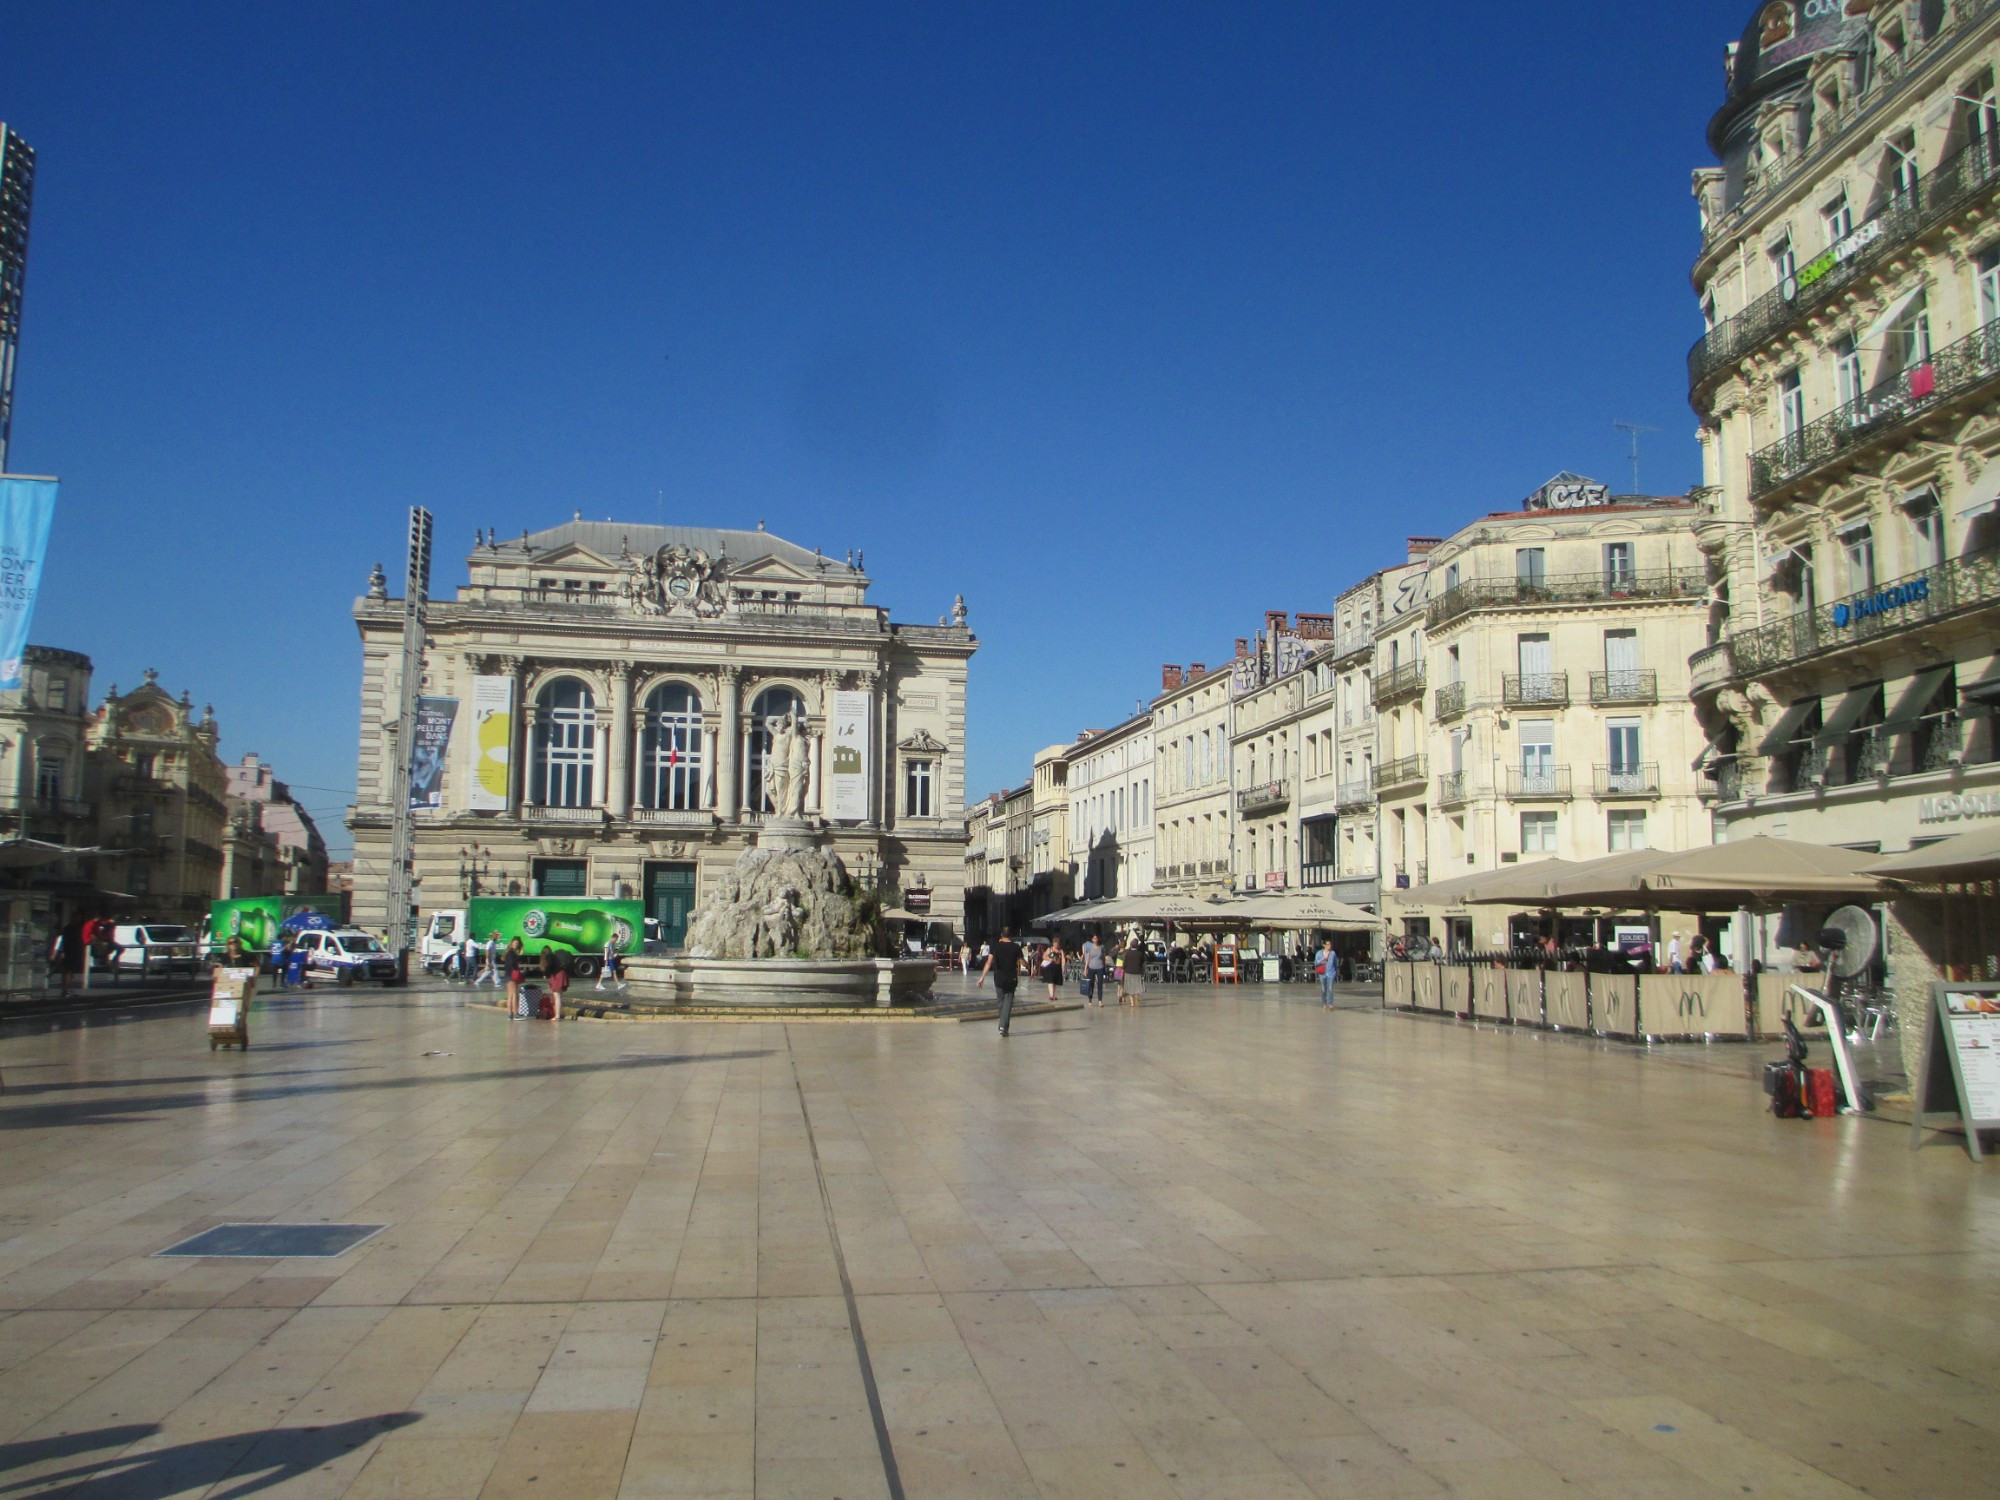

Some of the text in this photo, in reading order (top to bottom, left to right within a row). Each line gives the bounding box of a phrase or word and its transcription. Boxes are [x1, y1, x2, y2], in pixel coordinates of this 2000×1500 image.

[1853, 577, 1929, 621] BARCLAYS
[427, 717, 452, 725] MONT
[476, 708, 495, 724] 15
[416, 724, 447, 733] PELLIER
[838, 722, 856, 737] 16
[1620, 934, 1647, 942] SOLDES
